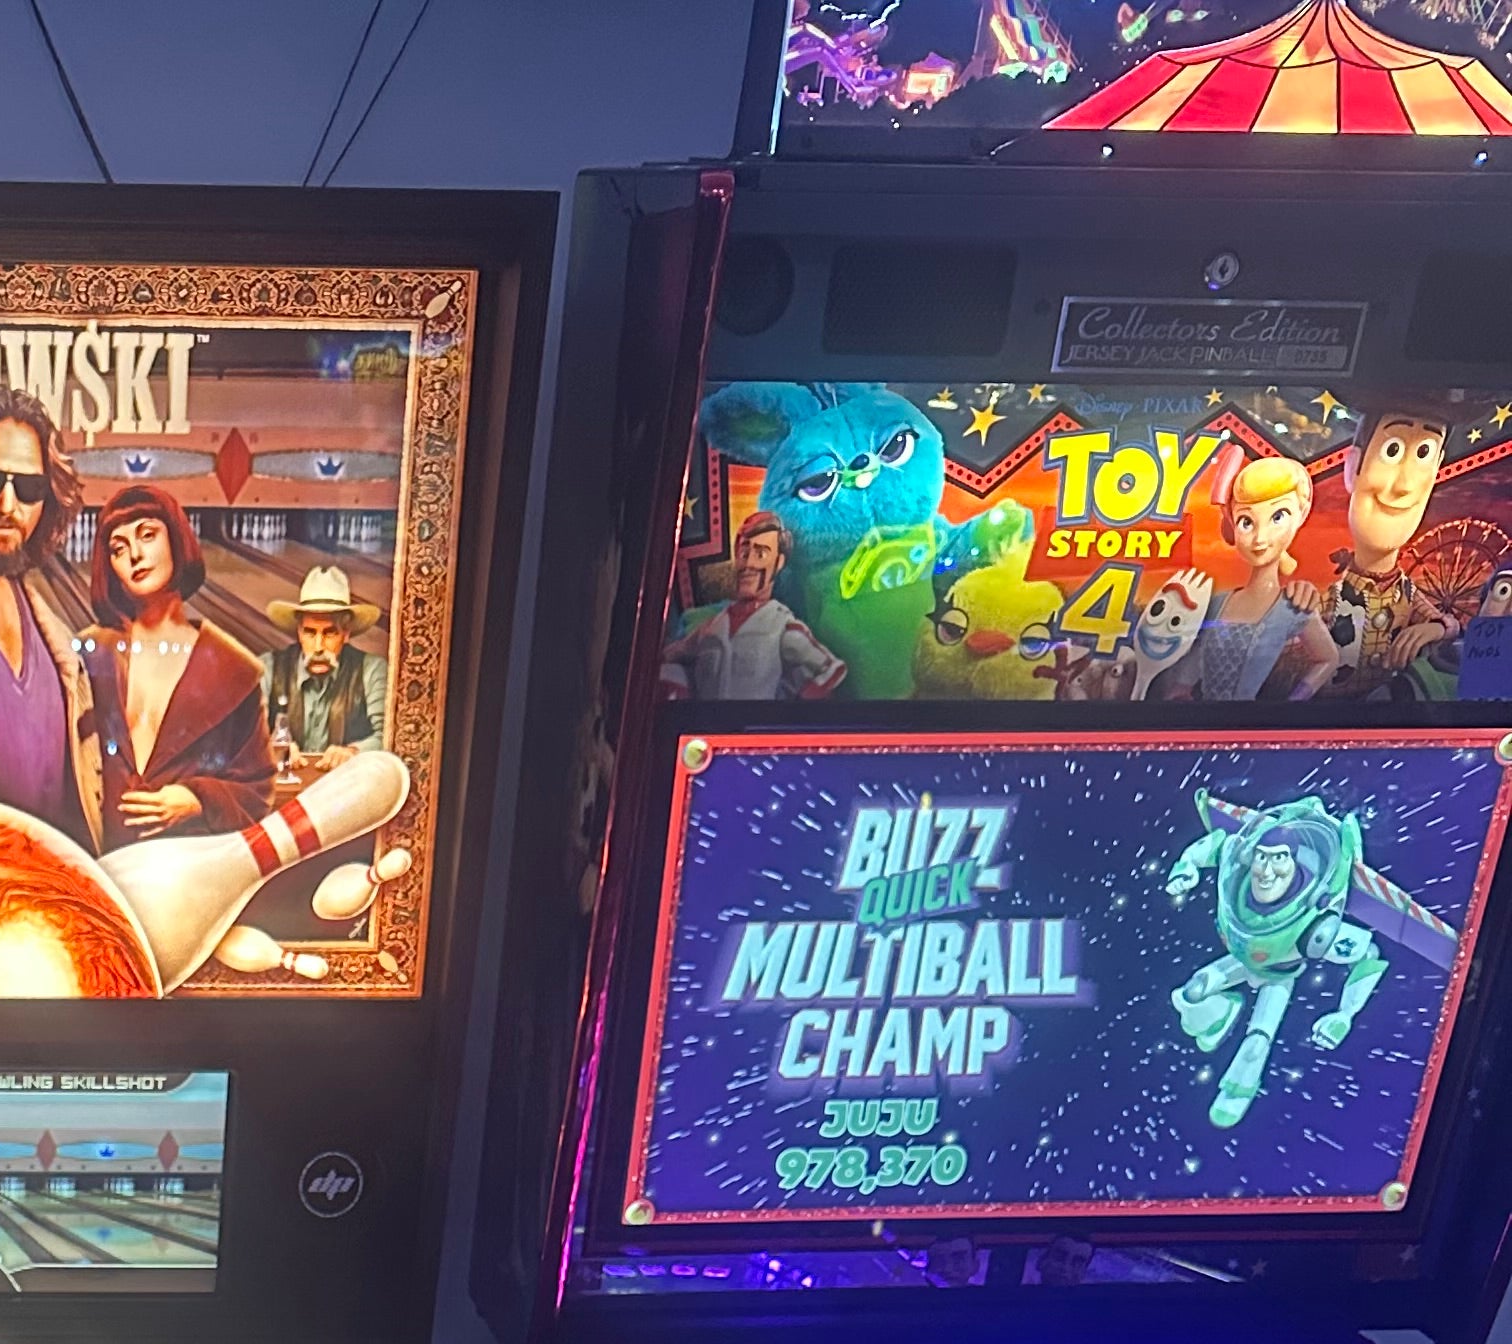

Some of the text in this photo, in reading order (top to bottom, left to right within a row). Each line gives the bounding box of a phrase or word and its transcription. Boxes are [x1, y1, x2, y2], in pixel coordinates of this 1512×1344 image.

[1230, 308, 1340, 343] Edition
[1061, 345, 1136, 365] JERSEY
[1137, 345, 1185, 363] JACK
[1190, 344, 1275, 364] PINBALL
[1143, 398, 1203, 414] PIXAR
[1046, 529, 1183, 560] STORY
[1060, 563, 1143, 657] 4
[837, 805, 1010, 893] BUZZ
[857, 860, 981, 925] QUICK
[724, 919, 1079, 1001] MULTIBALL
[778, 1006, 1010, 1080] CHAMP
[60, 1075, 168, 1090] SKILLSHOT
[823, 1098, 937, 1139] JUJU
[775, 1143, 967, 1196] 978,370
